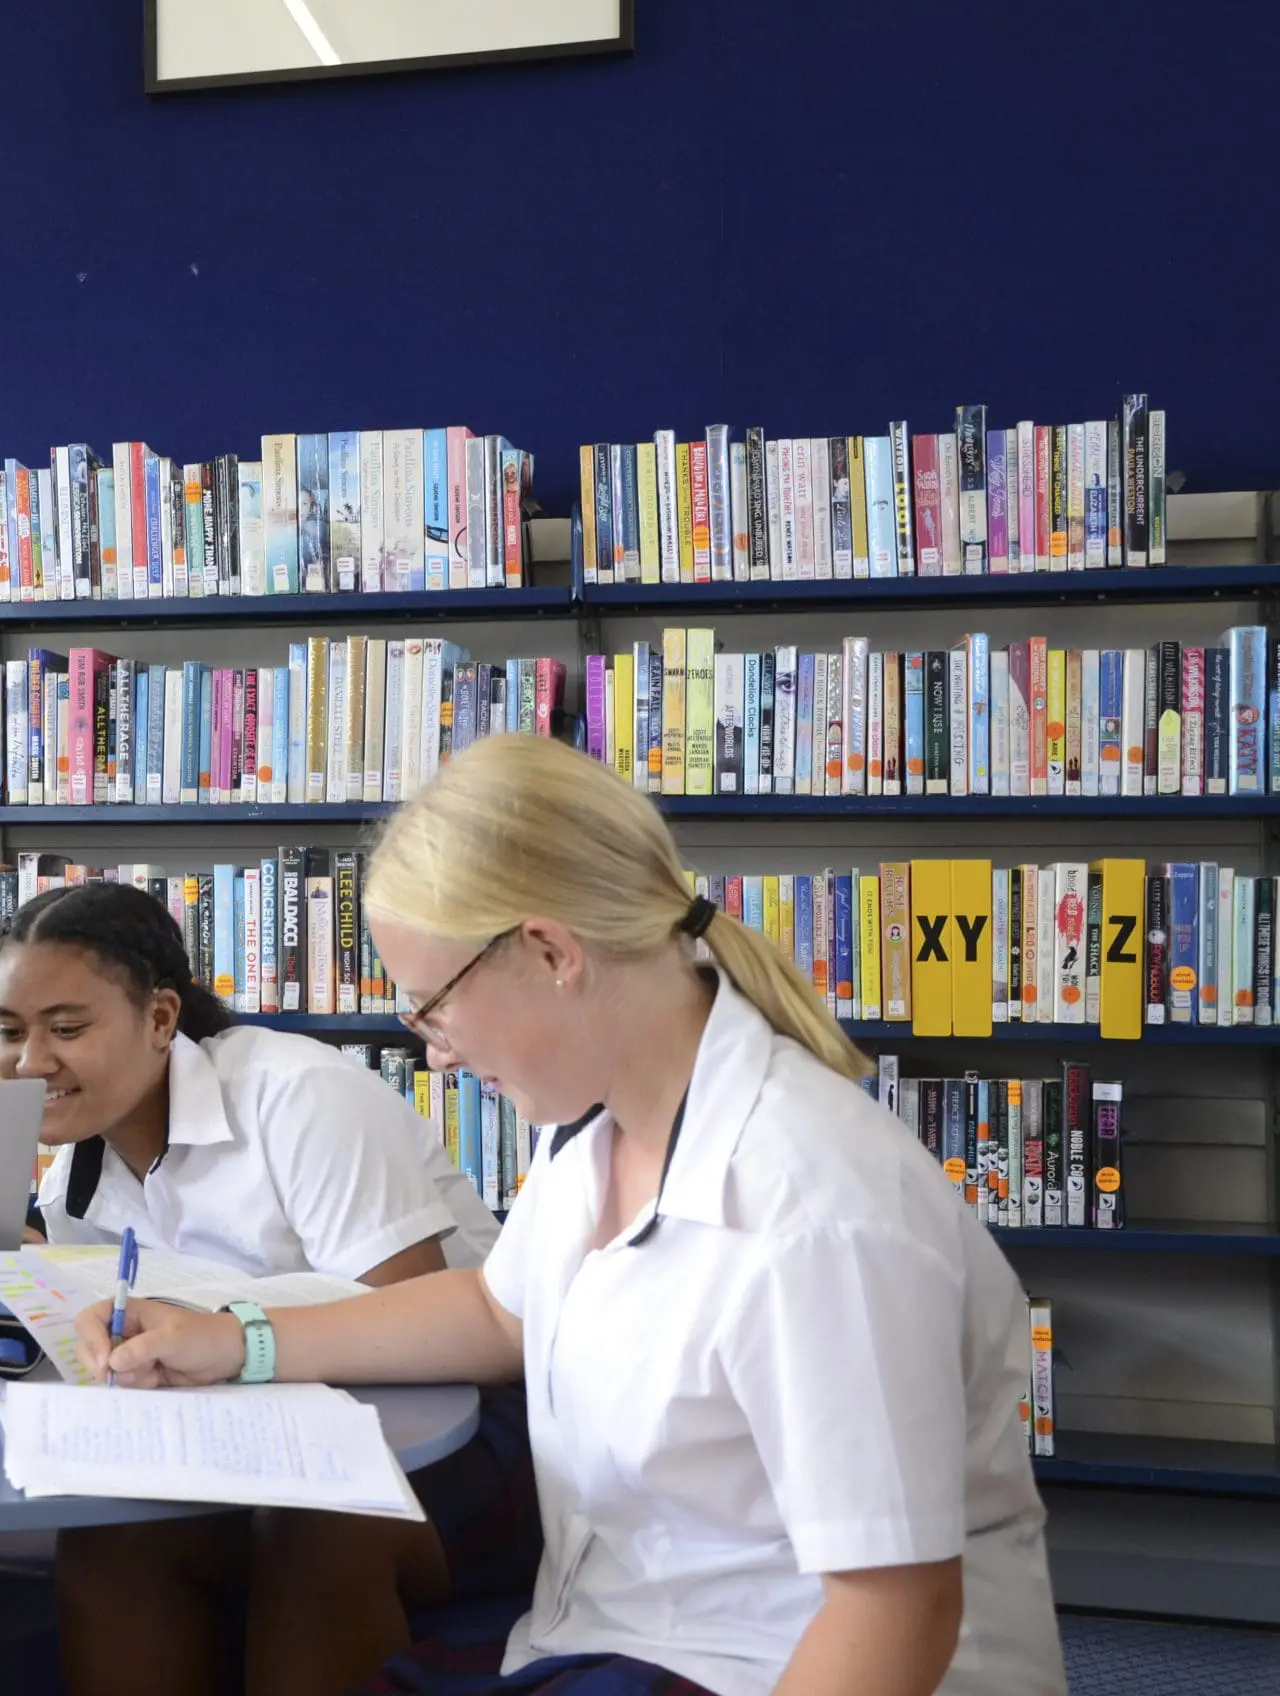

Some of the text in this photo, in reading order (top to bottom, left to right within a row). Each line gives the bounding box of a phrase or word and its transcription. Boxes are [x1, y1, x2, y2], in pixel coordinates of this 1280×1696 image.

[369, 441, 381, 486] Paullina
[1022, 439, 1033, 498] STRESSHEAD
[1128, 449, 1136, 475] PAULA
[1153, 414, 1163, 477] HORIZON
[404, 437, 417, 527] Paullina Simons
[798, 446, 808, 498] erin watt
[895, 429, 909, 538] WATSON LOOT
[1136, 436, 1145, 525] THE UNDERCURRENT
[203, 490, 213, 541] MORE HAPPY
[683, 506, 691, 546] TROUBLE
[1090, 490, 1099, 531] ELIZABETH
[151, 517, 159, 559] CHALLENGER
[78, 671, 86, 687] ROB
[428, 658, 440, 697] Danielle
[686, 668, 713, 680] ZEROES
[1165, 662, 1176, 704] WILKINSON
[1190, 666, 1199, 707] WILKINSON
[31, 693, 40, 728] COUNTRY
[78, 688, 86, 710] SMITH
[120, 669, 130, 760] ALL THE RAGE
[246, 671, 257, 744] THE EXACT OPPOSITE
[334, 677, 345, 721] DANIELLE
[651, 666, 660, 737] RAIN FALL ELLA
[748, 660, 758, 738] Dandelion Clocks
[933, 682, 943, 734] NOW RISE
[76, 738, 86, 765] child
[725, 705, 735, 758] AFTERWORLDS
[776, 700, 791, 772] Extraordinary
[872, 734, 880, 758] chosen
[1188, 720, 1198, 771] Zigzag Effect
[1237, 727, 1258, 774] KATY
[894, 876, 905, 909] ROSE
[1067, 869, 1079, 892] blood
[1091, 884, 1102, 915] YOUNG
[1152, 881, 1160, 902] ALLEN
[262, 863, 274, 956] CONCENTR8
[283, 877, 299, 947] BALDACCI
[339, 870, 353, 948] LEE CHILD
[815, 884, 825, 937] SIX IMPOSSIBLE
[248, 920, 256, 982] THE ONE
[916, 915, 988, 962] X Y
[1026, 926, 1035, 947] LEO
[1089, 943, 1100, 976] SHACK
[1107, 915, 1137, 963] Z
[1257, 914, 1270, 974] ALL THESE THINGS
[951, 1090, 960, 1120] FIERCE
[1069, 1067, 1080, 1126] blackman
[1025, 1140, 1042, 1176] RAIN
[1070, 1129, 1084, 1160] NOBLE
[1047, 1150, 1059, 1190] Aurora
